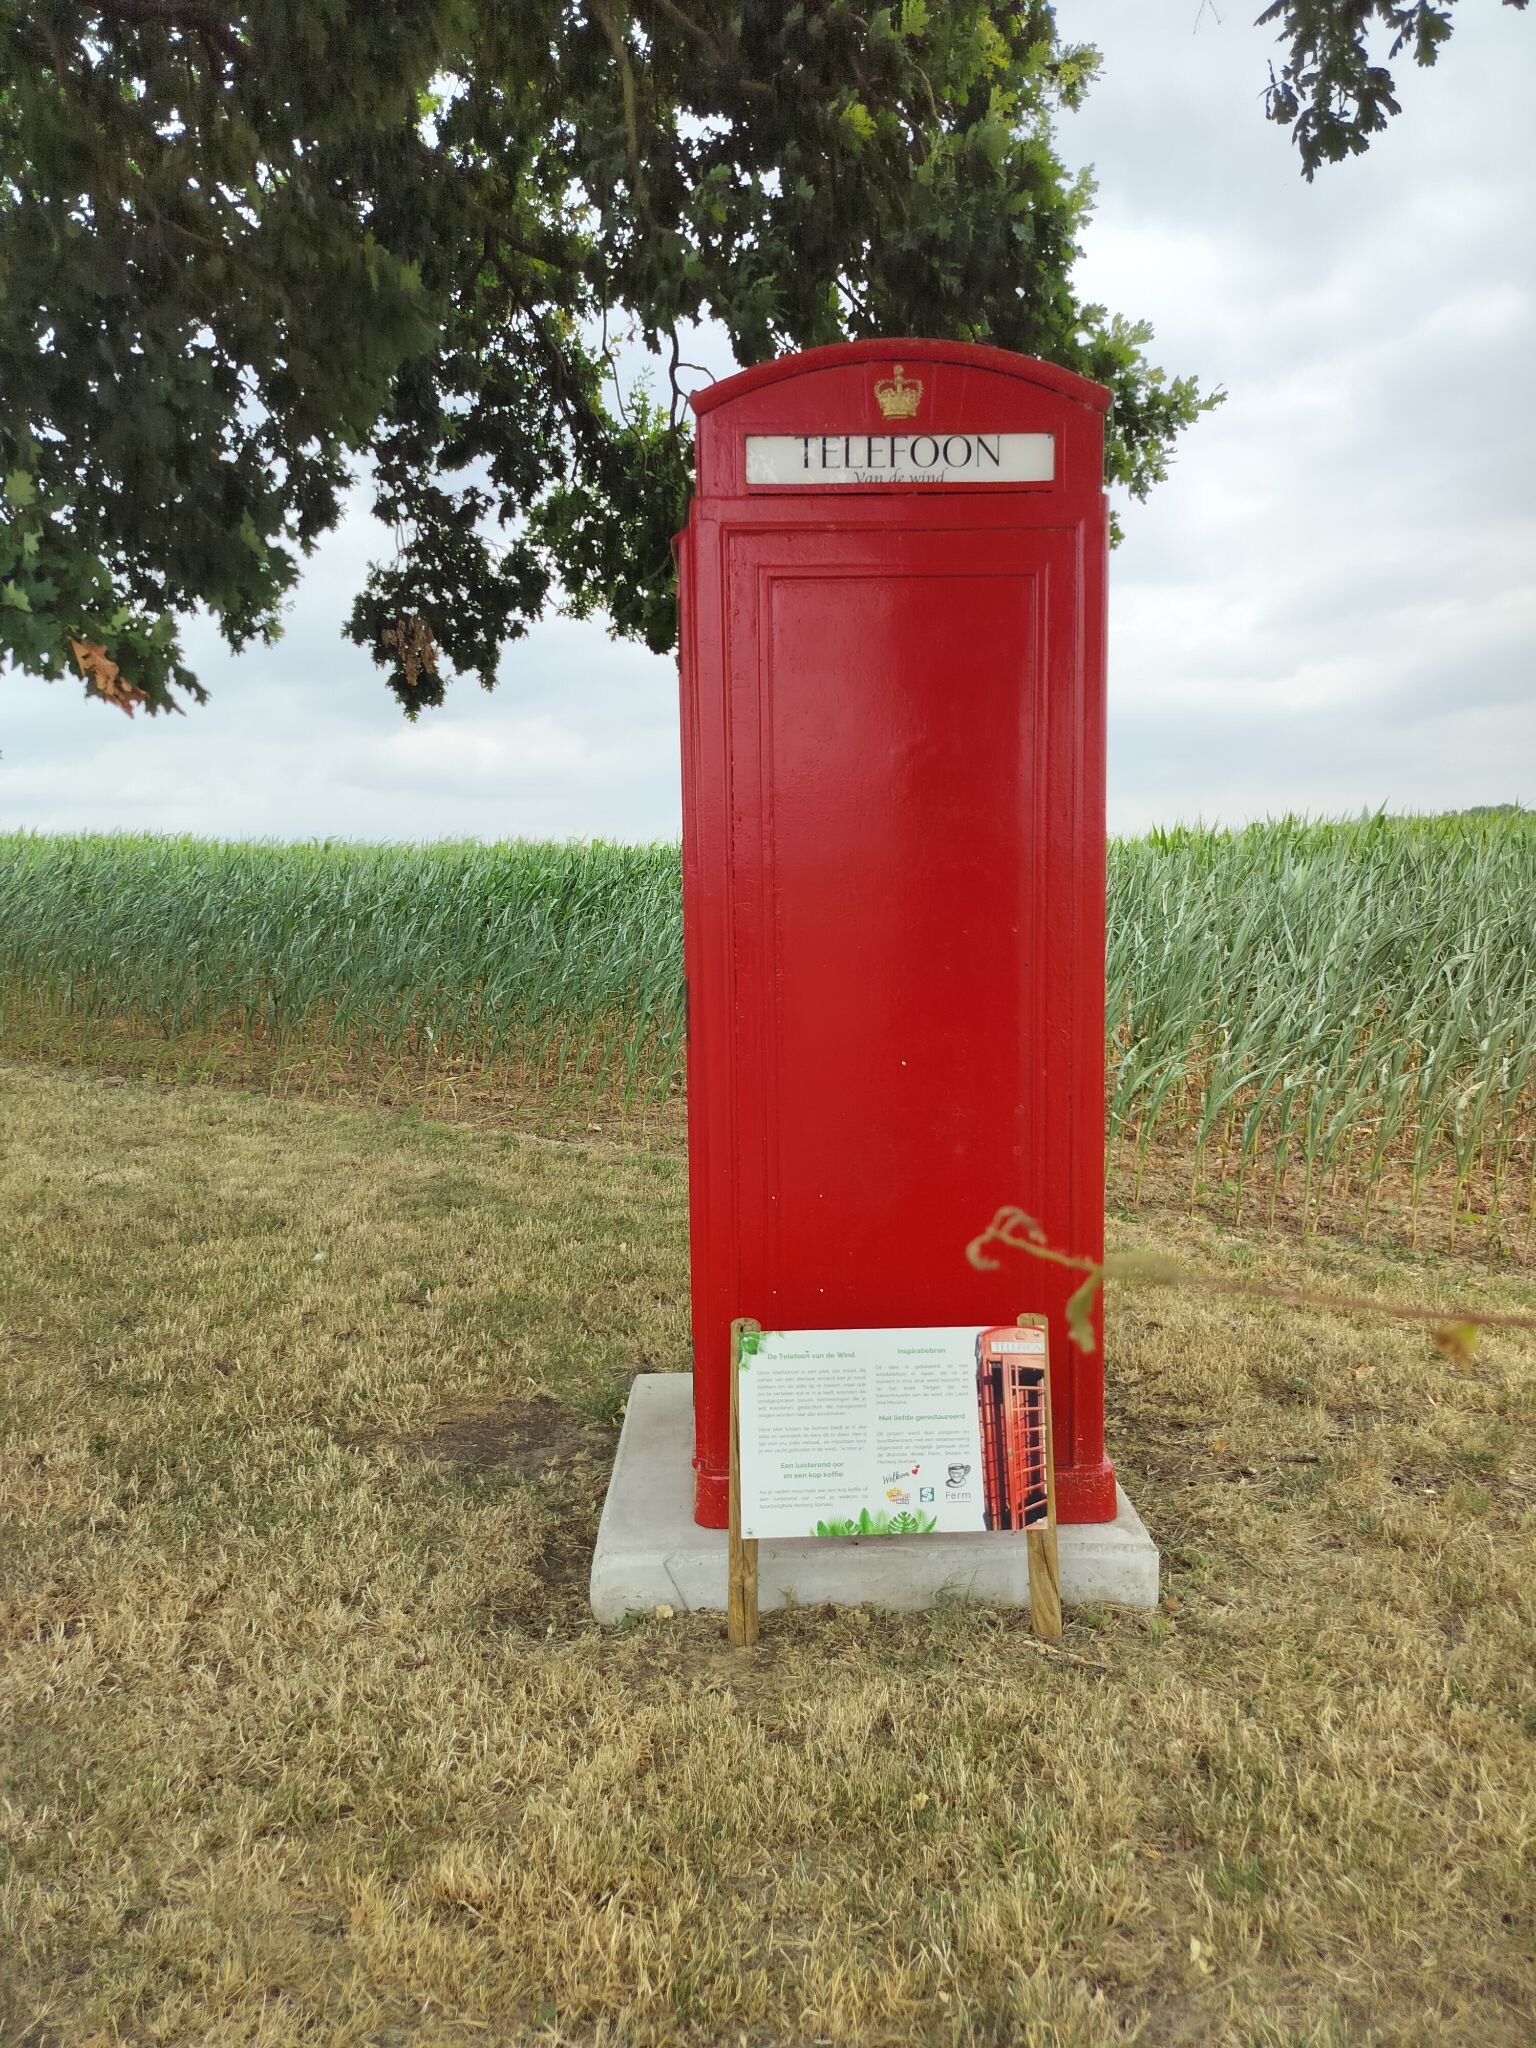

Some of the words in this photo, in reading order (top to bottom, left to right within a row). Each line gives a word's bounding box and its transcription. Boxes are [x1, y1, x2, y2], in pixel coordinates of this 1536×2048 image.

[795, 435, 1000, 468] TELEFOON
[854, 471, 883, 484] Van
[888, 467, 905, 484] de
[909, 467, 948, 484] wind
[836, 1351, 856, 1359] Wind
[878, 1413, 892, 1421] Met
[893, 1413, 914, 1421] liefde
[808, 1471, 822, 1480] kop
[823, 1470, 844, 1478] koffie
[945, 1491, 971, 1500] Ferm
